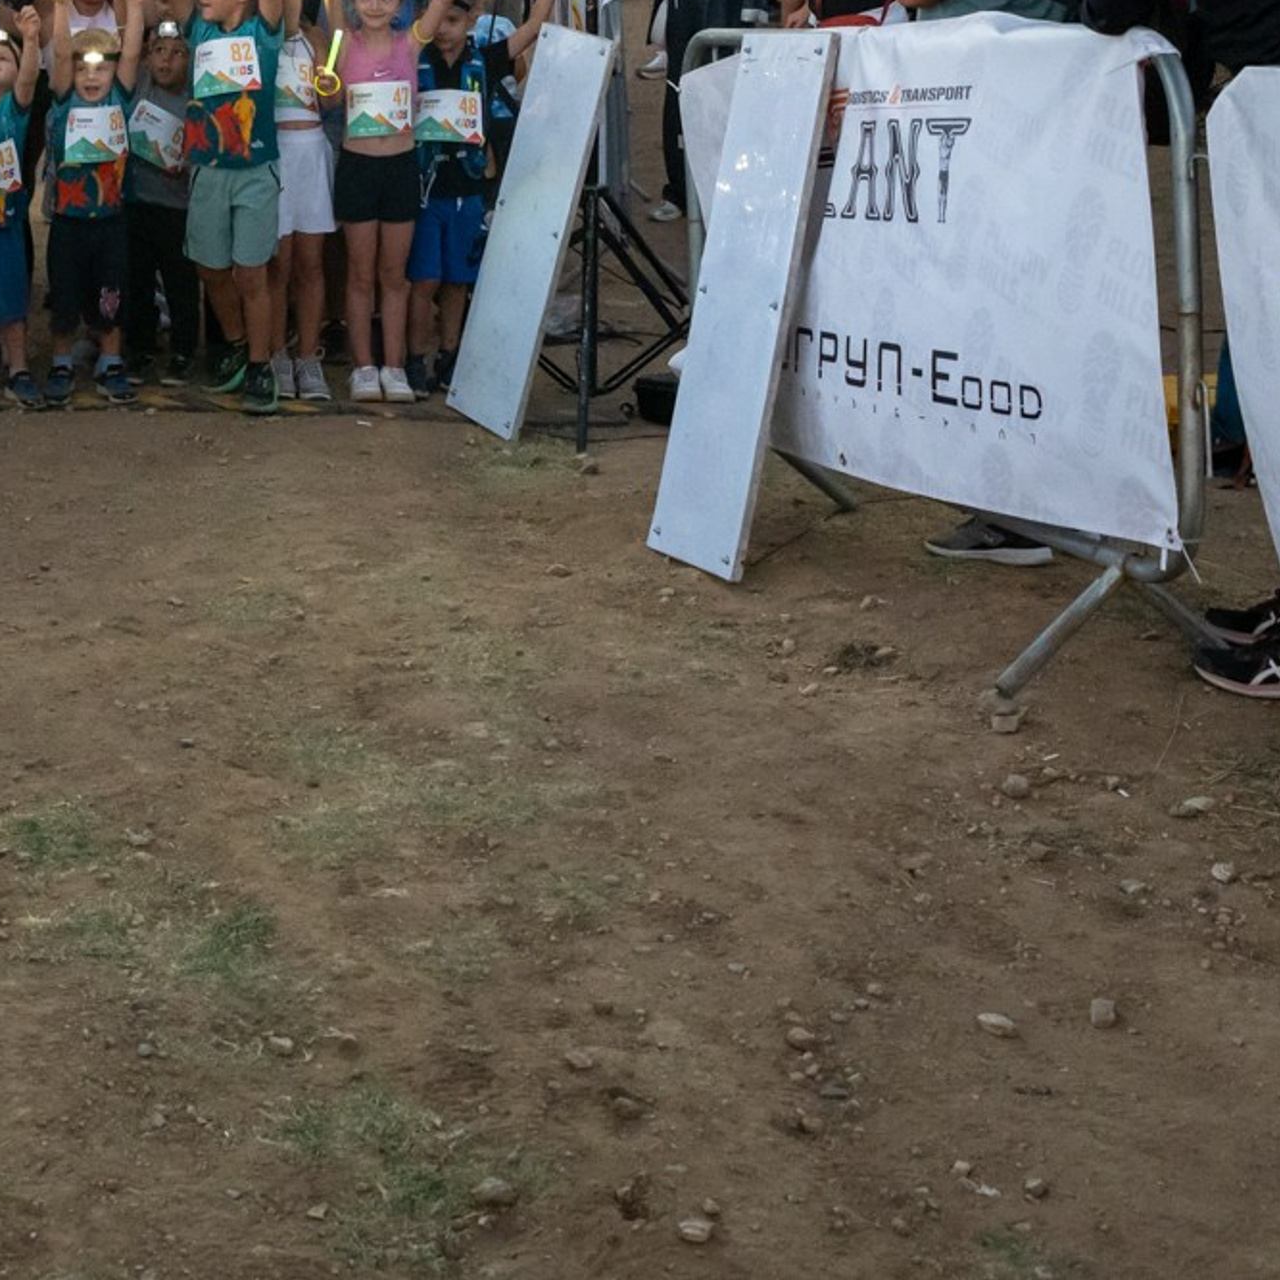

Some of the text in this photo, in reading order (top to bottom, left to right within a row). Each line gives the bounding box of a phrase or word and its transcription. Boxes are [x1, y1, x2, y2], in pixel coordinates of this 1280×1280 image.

[230, 42, 254, 62] 82
[229, 64, 254, 76] KIDS
[393, 87, 409, 106] 47
[900, 86, 972, 104] TRANSPORT
[458, 96, 478, 117] 48
[455, 119, 478, 130] KIDS
[824, 117, 972, 223] ANT
